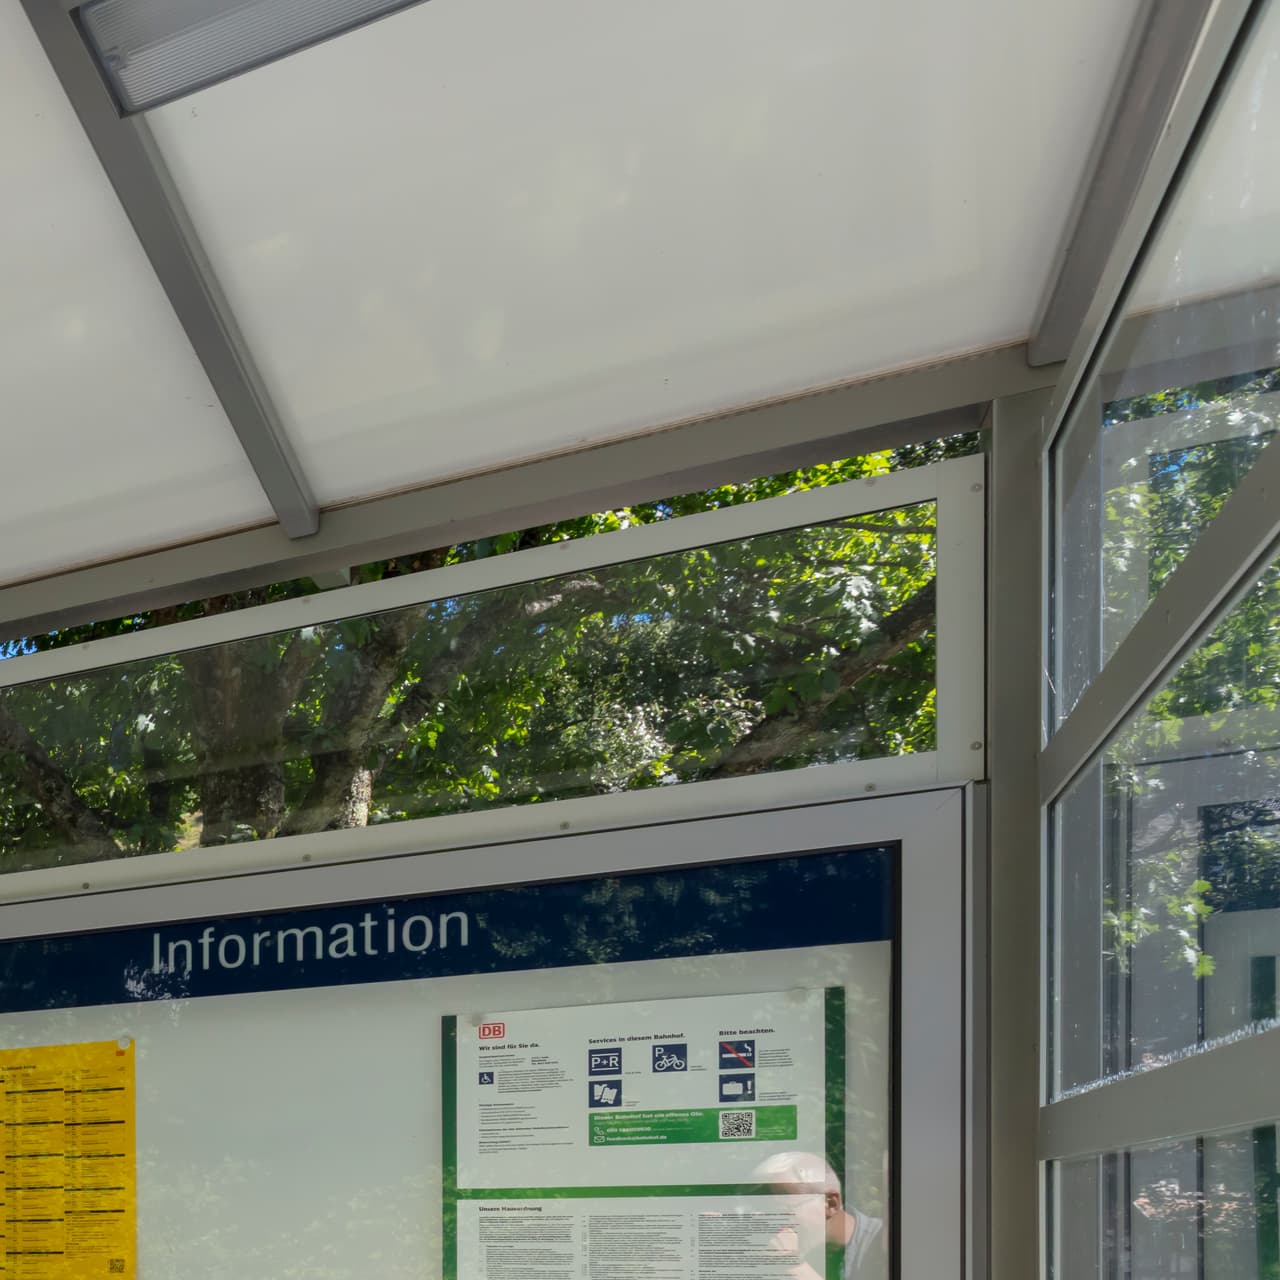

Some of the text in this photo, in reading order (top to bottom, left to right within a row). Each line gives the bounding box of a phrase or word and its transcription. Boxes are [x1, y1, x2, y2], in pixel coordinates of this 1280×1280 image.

[153, 908, 469, 975] Information
[481, 1024, 503, 1038] DB
[655, 1047, 664, 1057] P
[591, 1056, 619, 1068] P+R
